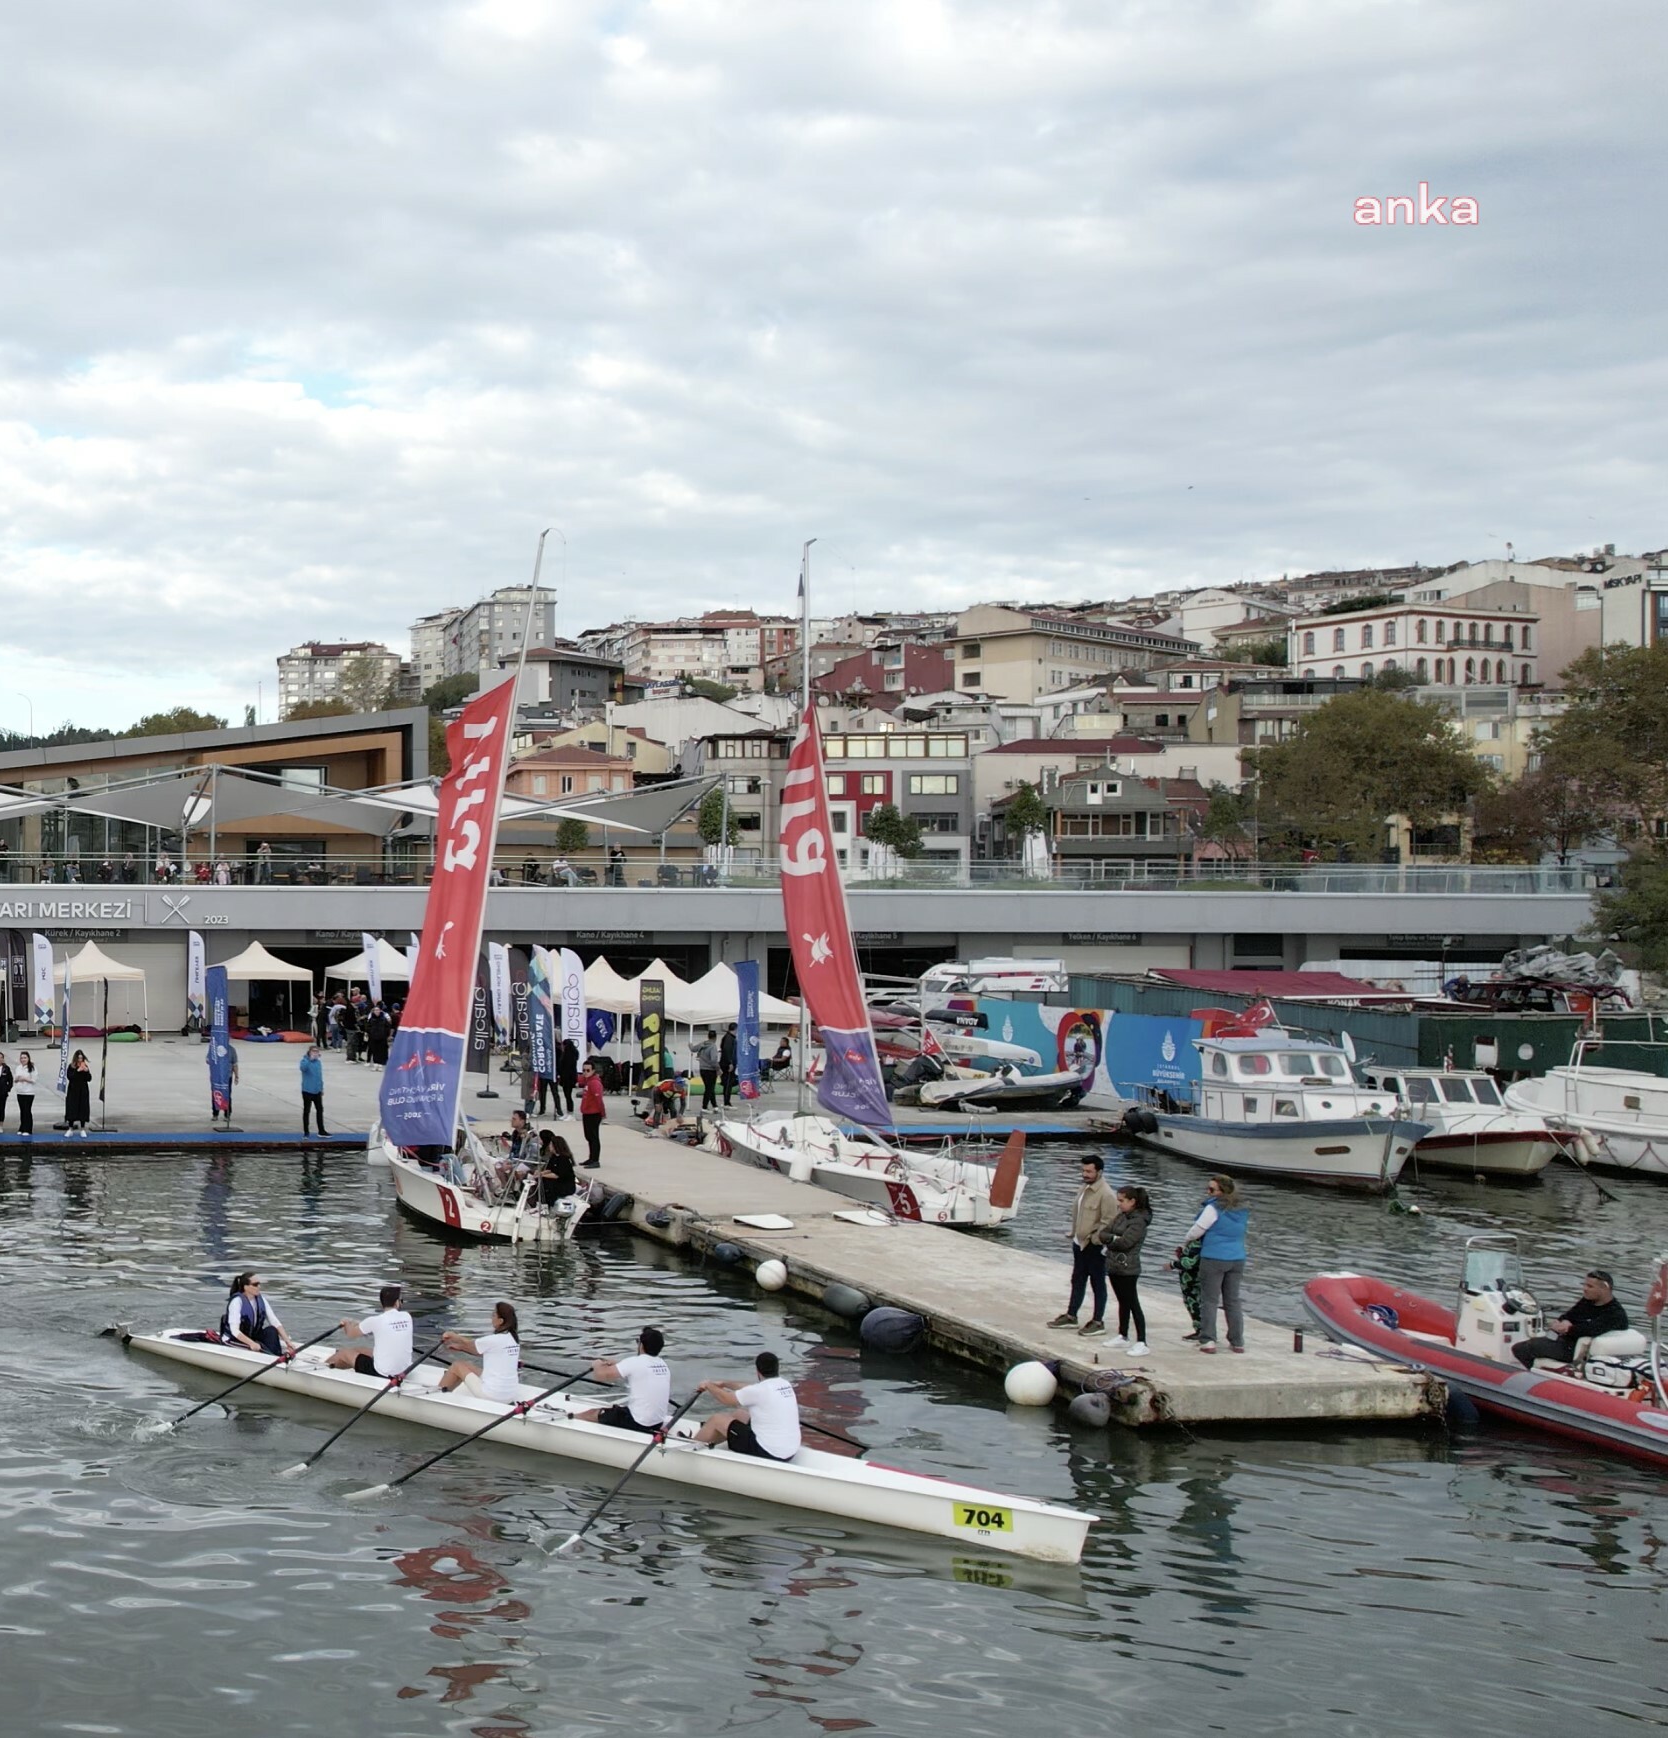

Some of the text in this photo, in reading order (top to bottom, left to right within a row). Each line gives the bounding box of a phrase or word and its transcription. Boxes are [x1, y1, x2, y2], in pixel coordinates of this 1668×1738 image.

[39, 899, 131, 918] MERKEZİ
[204, 915, 229, 924] 2023
[75, 929, 114, 939] Kayıkhane
[601, 931, 638, 940] Kayıkhane
[956, 1016, 978, 1026] ADANA
[445, 1193, 455, 1218] 2
[898, 1192, 912, 1215] 5
[940, 1211, 946, 1221] 5
[482, 1222, 490, 1231] 2
[963, 1508, 1005, 1529] 704
